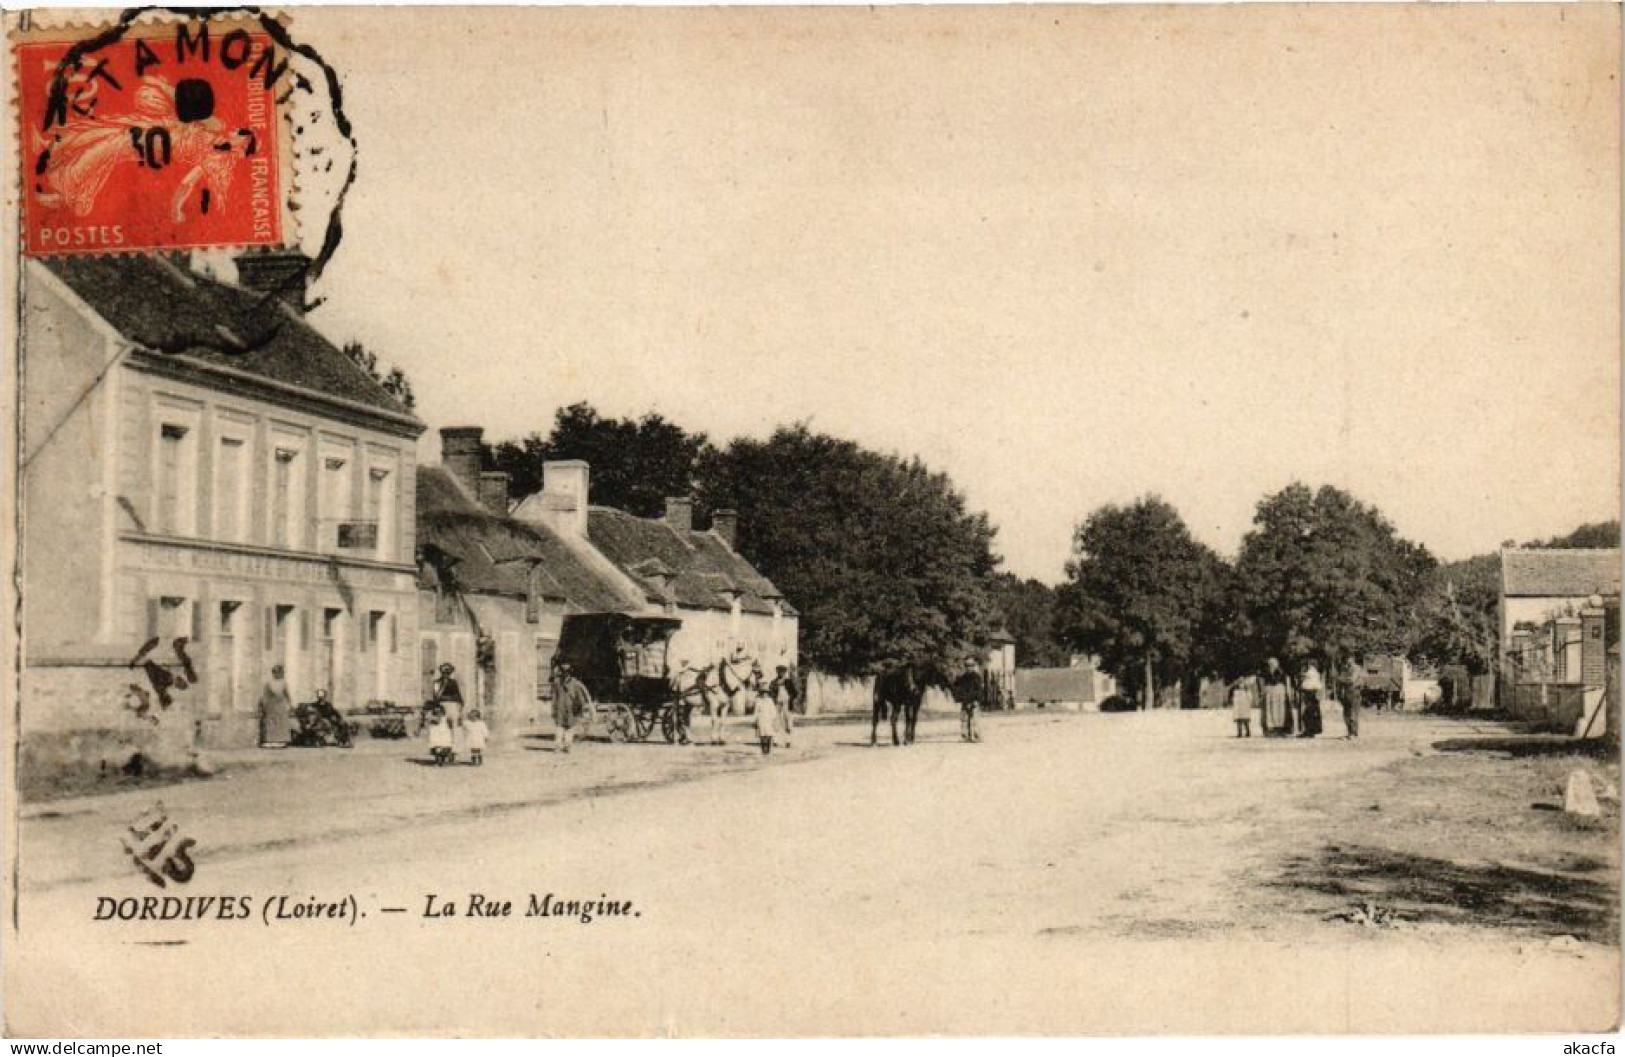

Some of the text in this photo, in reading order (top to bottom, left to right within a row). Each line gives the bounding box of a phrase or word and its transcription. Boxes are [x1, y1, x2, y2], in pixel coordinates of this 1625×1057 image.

[41, 224, 124, 246] POSTES
[93, 895, 253, 920] DORDIVES
[262, 894, 367, 927] (Loiret).
[422, 894, 456, 918] La
[465, 893, 512, 918] Rue
[524, 893, 642, 924] Mangine.
